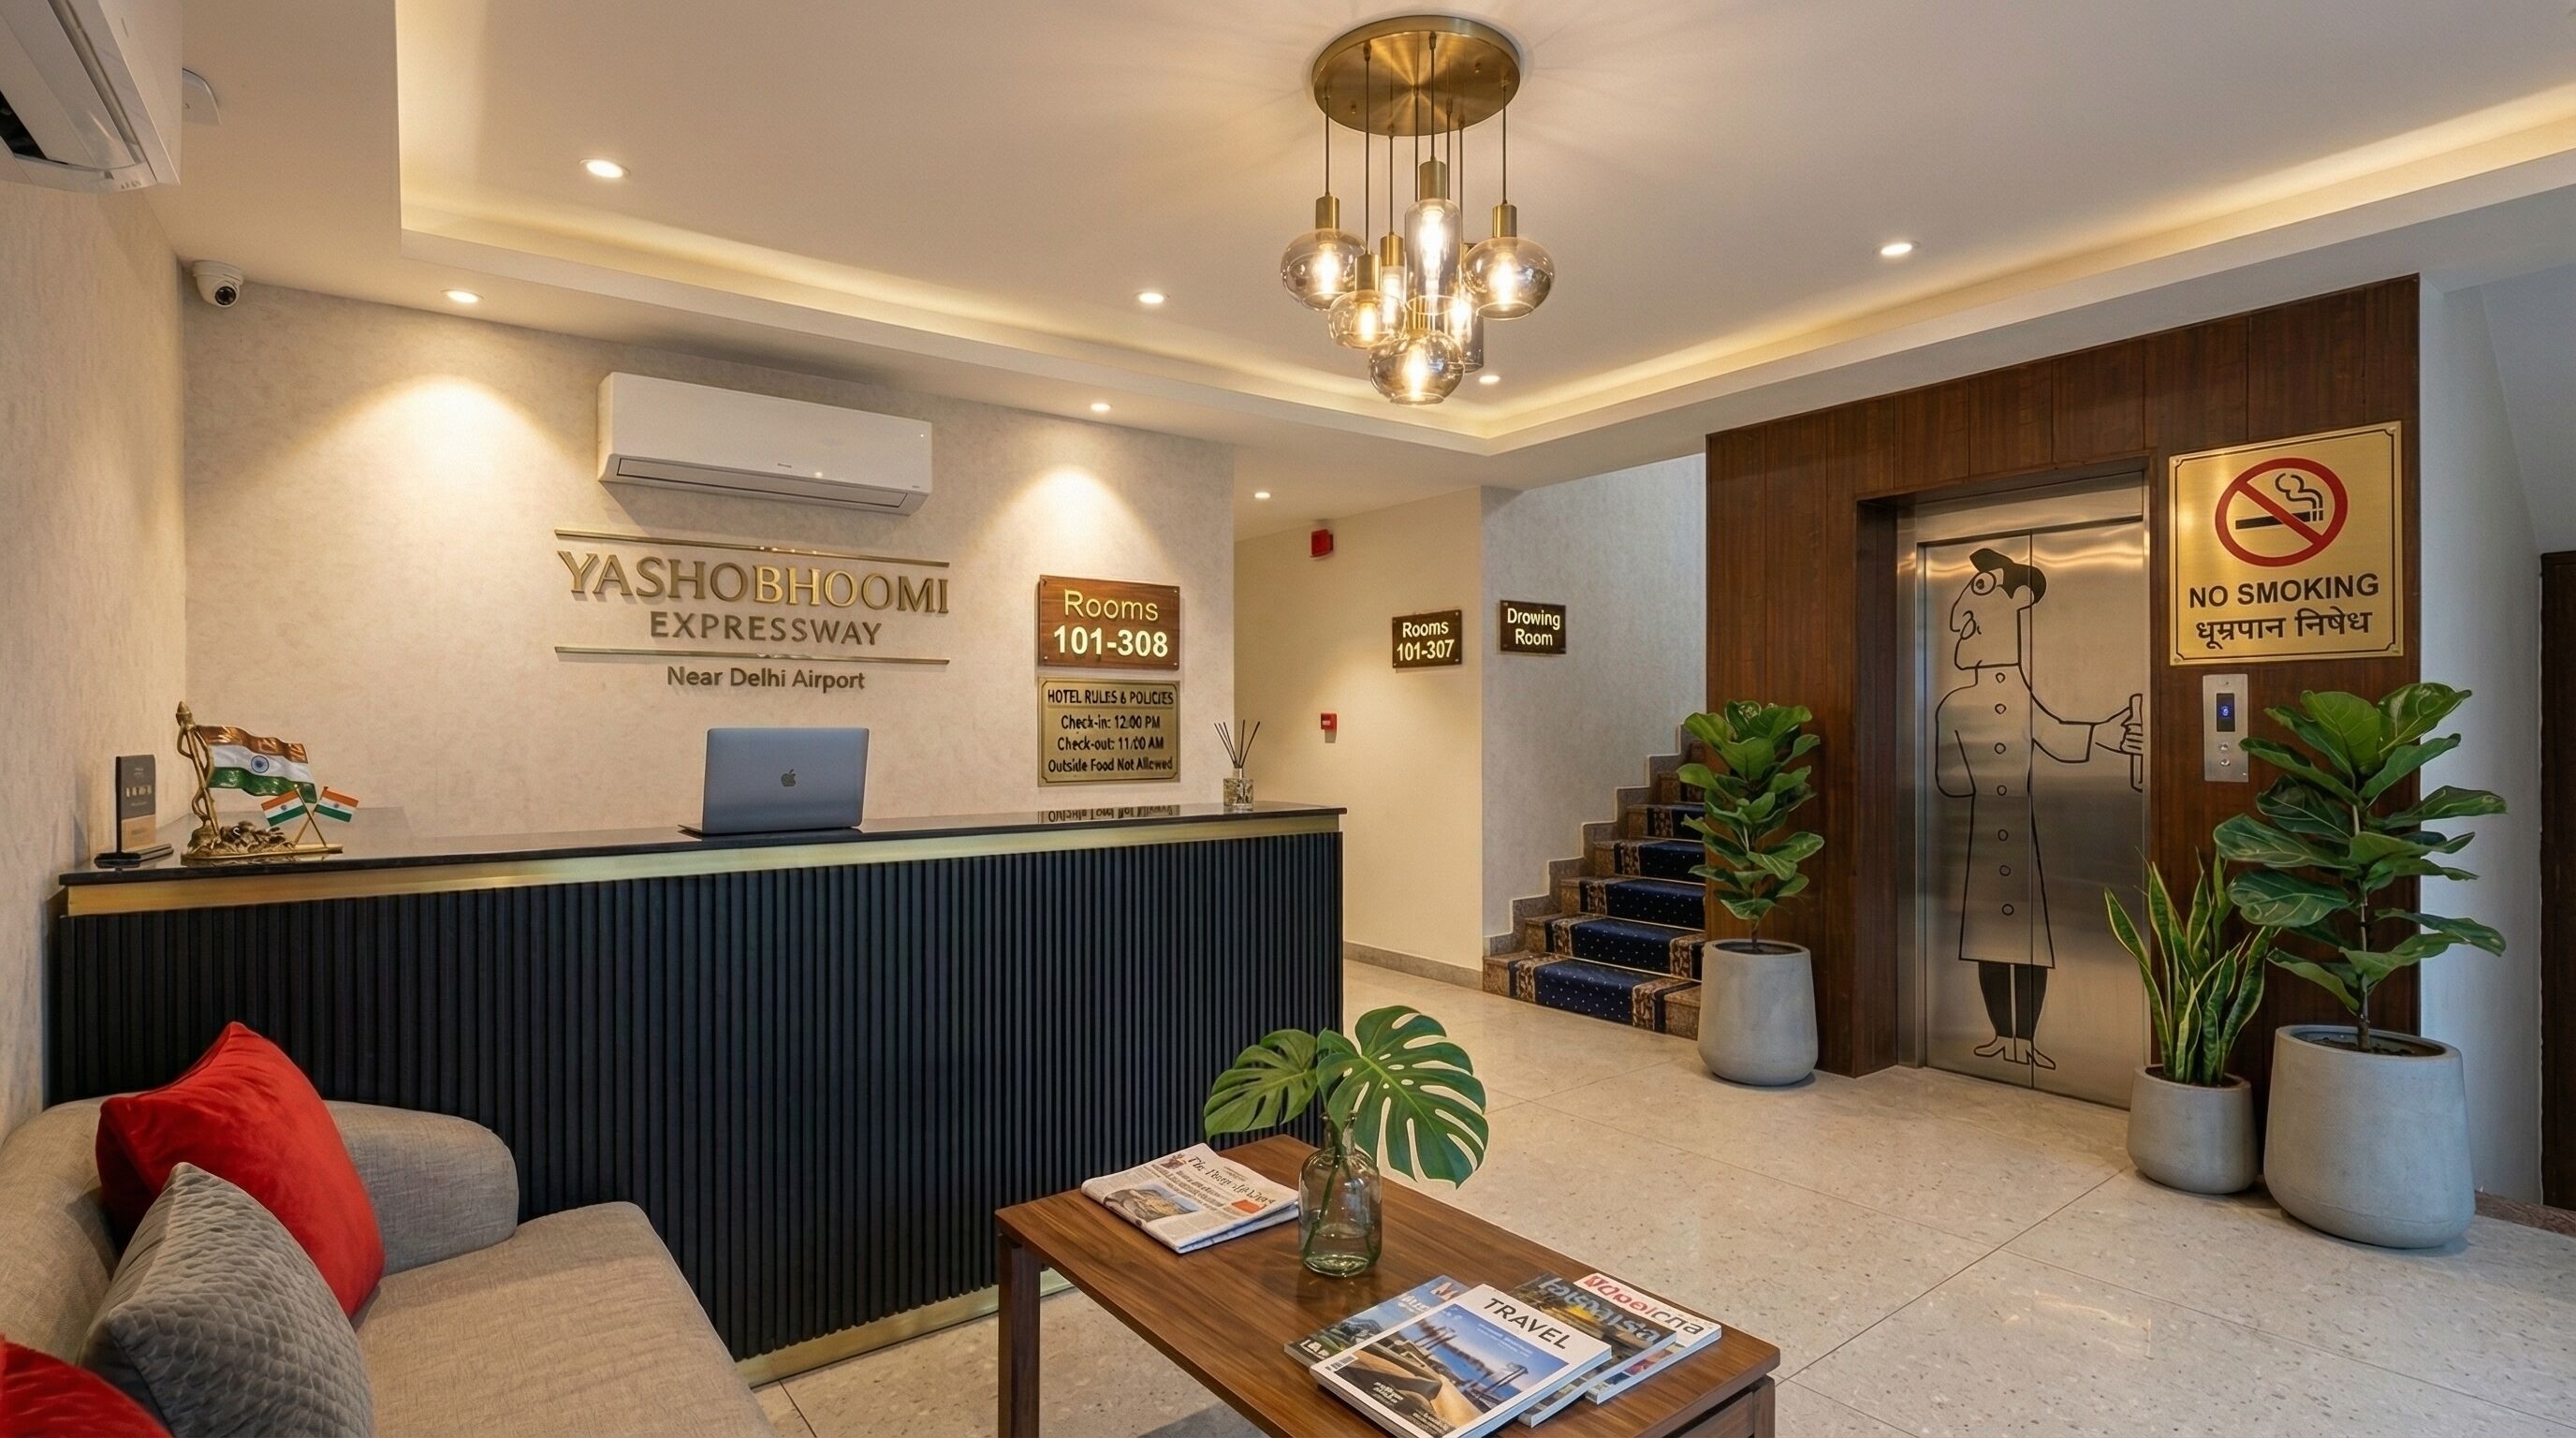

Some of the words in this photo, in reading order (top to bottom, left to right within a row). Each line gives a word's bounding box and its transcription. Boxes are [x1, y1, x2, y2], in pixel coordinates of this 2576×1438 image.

[557, 550, 949, 614] YASHOBHOOMI
[2189, 585, 2228, 609] NO
[2237, 573, 2379, 605] SMOKING
[1064, 589, 1160, 622] Rooms
[650, 610, 882, 646] EXPRESSWAY
[1402, 621, 1449, 638] Rooms
[1507, 608, 1560, 630] Drowing
[2196, 617, 2286, 650] धूम्रपान
[2295, 606, 2373, 638] निषेध
[1054, 624, 1168, 657] 101-308
[1515, 628, 1553, 646] Room
[1397, 639, 1455, 661] 101-307
[666, 666, 723, 686] Near
[731, 668, 785, 688] Delhi
[792, 668, 865, 693] Airport
[1047, 689, 1081, 704] HOTEL
[1085, 689, 1118, 704] RULES
[1130, 691, 1174, 705] POLICIES
[1061, 714, 1111, 729] Check-in:
[1145, 715, 1161, 729] PM
[1148, 736, 1164, 750] AM
[1048, 758, 1088, 772] Outside
[1090, 757, 1115, 771] Food
[1117, 757, 1134, 771] Not
[1484, 1298, 1572, 1350] TRAVEL
